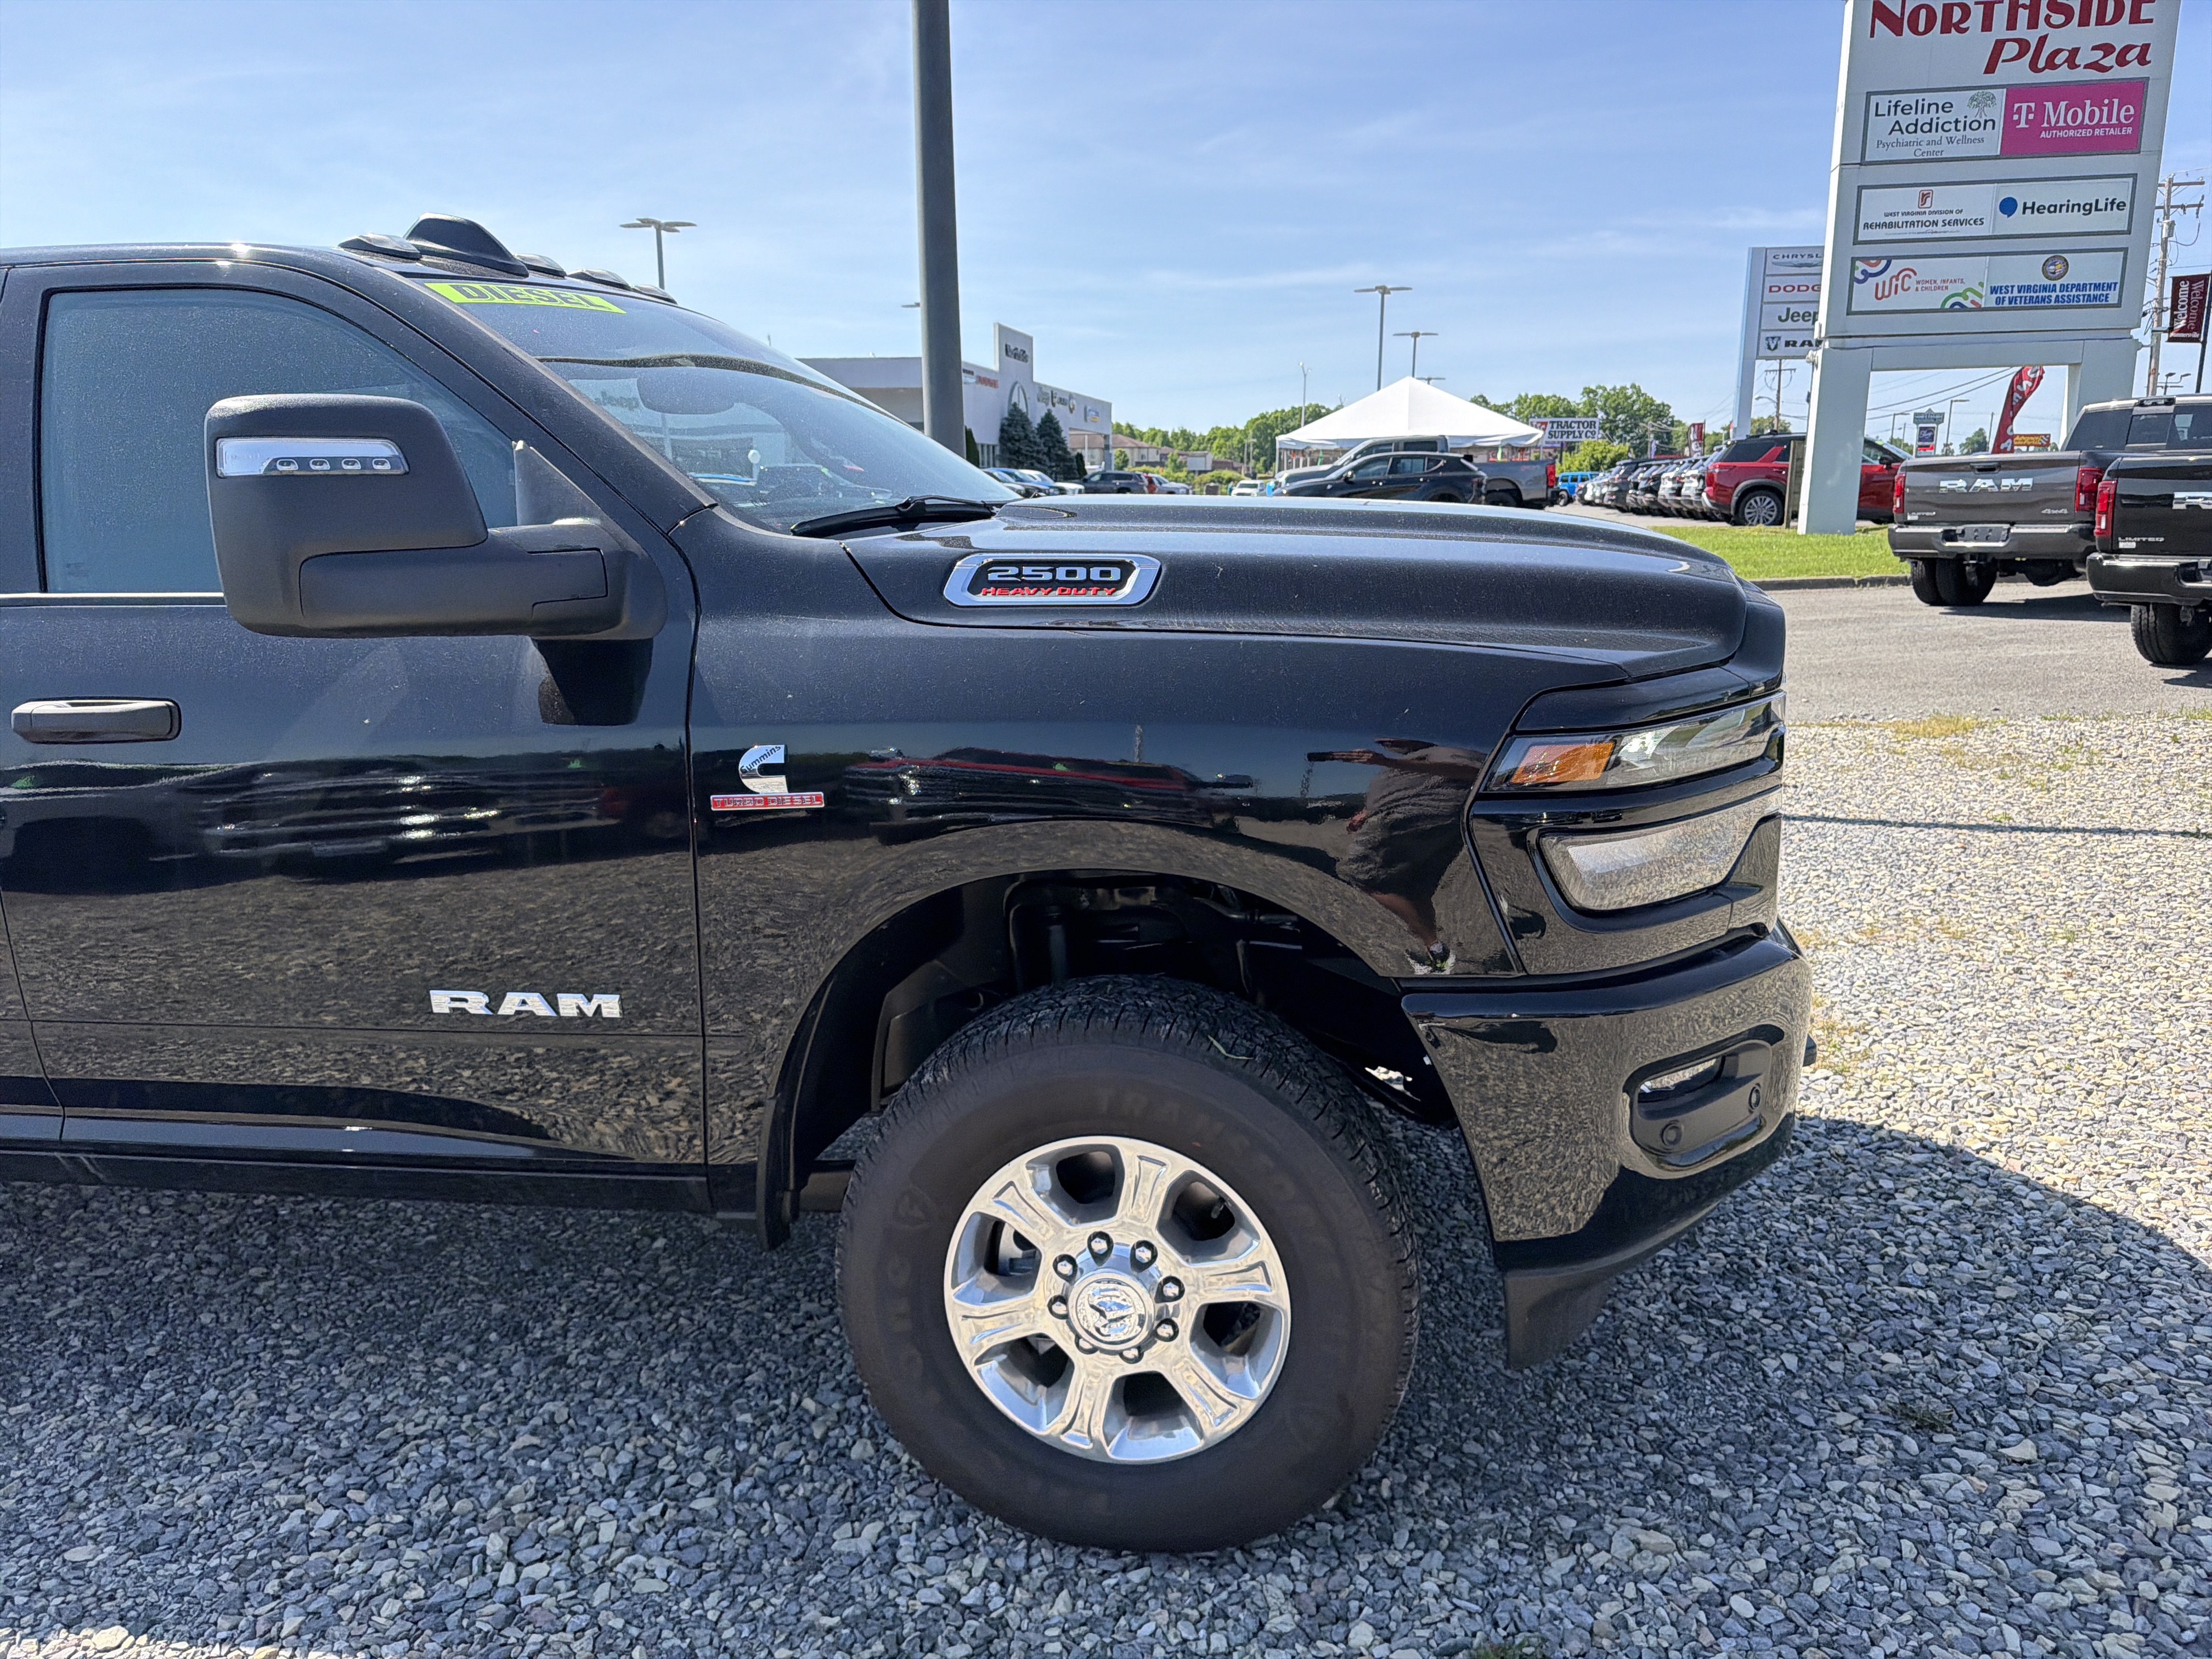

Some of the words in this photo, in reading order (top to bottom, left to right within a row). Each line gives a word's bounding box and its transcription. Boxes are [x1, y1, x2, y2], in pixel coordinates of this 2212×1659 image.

[1869, 0, 2155, 38] NORTHSIDE
[1983, 32, 2152, 75] Plaza
[1875, 98, 1954, 117] Lifeline
[2041, 98, 2135, 127] Mobile
[1888, 115, 1996, 136] Addiction
[2040, 128, 2093, 139] AUTHORIZED
[2095, 127, 2132, 136] RETAILER
[1876, 138, 1923, 151] Psychiatric
[1926, 136, 1943, 146] and
[1945, 134, 1985, 145] Wellness
[1914, 148, 1945, 157] Center
[2022, 197, 2127, 216] HearingLife
[1863, 219, 1939, 230] REHABILITATION
[1941, 217, 1985, 228] SERVICES
[1768, 284, 1821, 294] DODG
[1990, 284, 2016, 295] WEST
[2017, 283, 2057, 294] VIRGINIA
[2058, 281, 2119, 294] DEPARTMENT
[448, 284, 618, 311] DIESEL
[1995, 295, 2007, 306] OF
[2008, 294, 2052, 306] VETERANS
[2053, 292, 2111, 304] ASSISTANCE
[2173, 280, 2190, 329] Welcome
[2187, 280, 2205, 330] Welcome
[1549, 420, 1596, 429] TRACTOR
[1548, 430, 1584, 439] SUPPLY
[1939, 477, 2033, 493] RAM
[988, 566, 1121, 582] 2500
[981, 587, 1053, 596] HEAVY
[1056, 586, 1116, 596] DUTY
[713, 797, 764, 808] TURBO
[768, 795, 823, 805] DIESEL
[429, 989, 623, 1018] RAM
